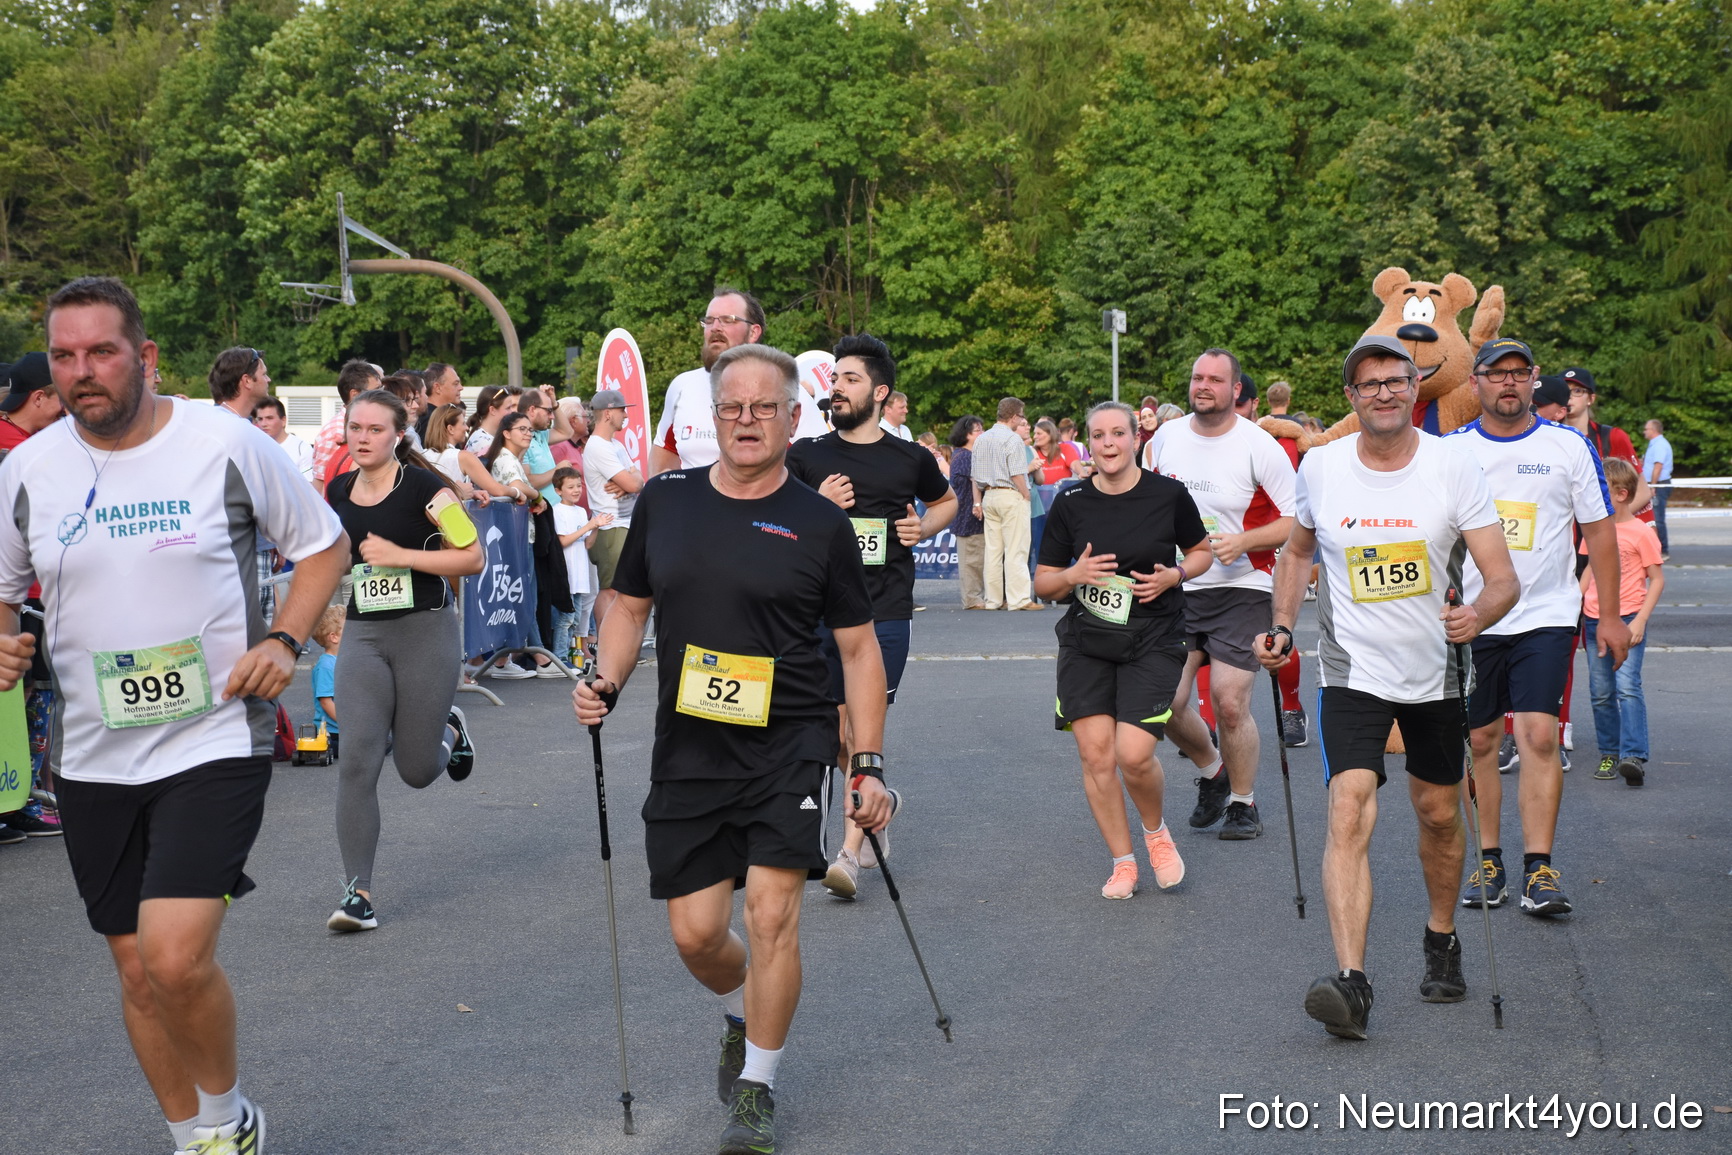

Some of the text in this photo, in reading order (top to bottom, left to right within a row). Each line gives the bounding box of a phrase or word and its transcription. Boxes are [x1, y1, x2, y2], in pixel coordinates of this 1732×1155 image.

[1518, 463, 1550, 475] GOSSNER
[95, 500, 192, 524] HAUBNER
[108, 518, 181, 538] TREPPEN
[1360, 518, 1418, 528] KLEBL
[1359, 562, 1419, 586] 1158
[361, 576, 403, 598] 1884
[1080, 584, 1122, 609] 1863
[1386, 582, 1416, 591] Bernhard
[179, 658, 197, 668] 2019
[120, 671, 184, 705] 998
[706, 676, 741, 704] 52
[124, 698, 190, 714] Hofmann Stefan
[700, 699, 744, 712] Ulrich Rainer
